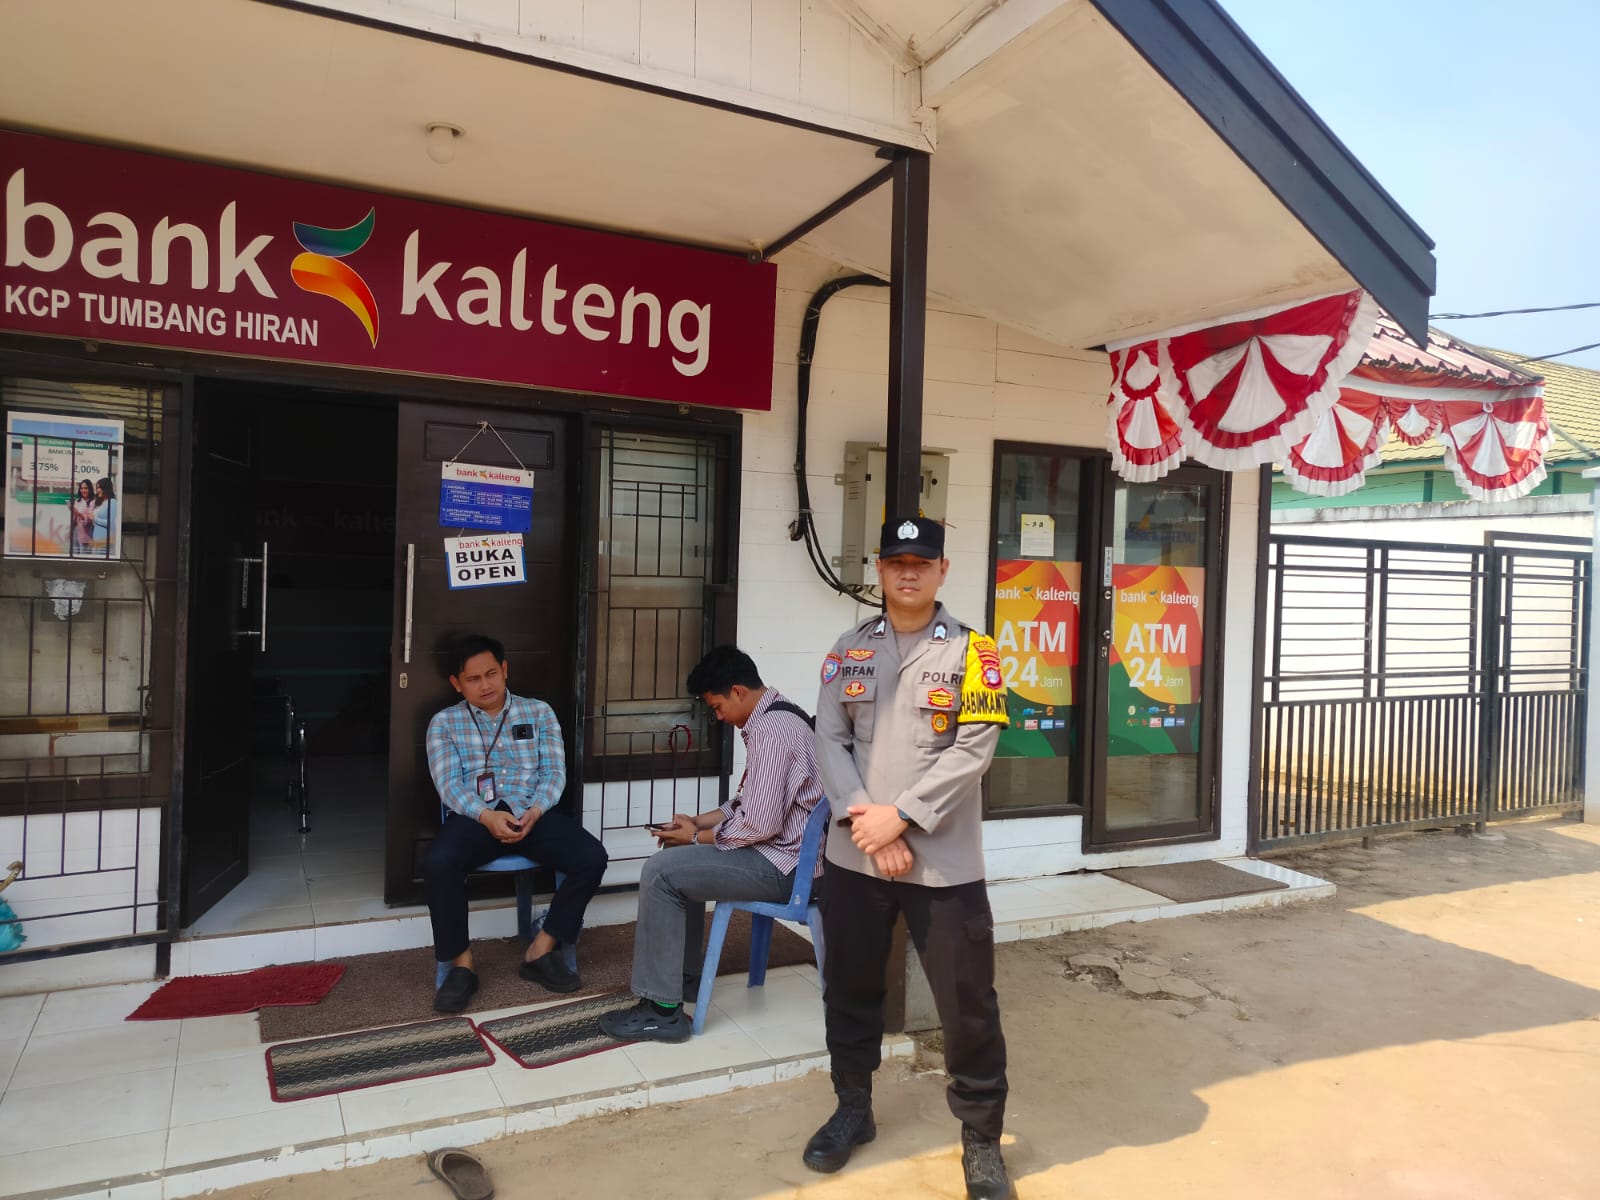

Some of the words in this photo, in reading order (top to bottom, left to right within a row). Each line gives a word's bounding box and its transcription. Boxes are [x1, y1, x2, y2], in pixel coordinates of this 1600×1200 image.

[5, 168, 278, 299] bank
[401, 229, 711, 377] kalteng
[5, 285, 70, 318] KCP
[78, 292, 227, 337] TUMBANG
[235, 310, 318, 347] HIRAN
[456, 468, 478, 478] bank
[488, 471, 521, 483] kalteng
[459, 540, 480, 549] bank
[491, 537, 523, 548] kalteng
[455, 548, 514, 564] BUKA
[457, 565, 516, 581] OPEN
[1036, 587, 1081, 605] kalteng
[1120, 589, 1147, 603] bank
[1160, 590, 1199, 608] kalteng
[997, 620, 1067, 653] ATM
[1124, 623, 1187, 654] ATM
[842, 666, 876, 678] IRFAN
[921, 671, 963, 685] POLRI
[1002, 656, 1039, 688] 24
[1041, 676, 1063, 688] Jam
[1129, 656, 1162, 688] 24
[1164, 677, 1184, 688] Jam
